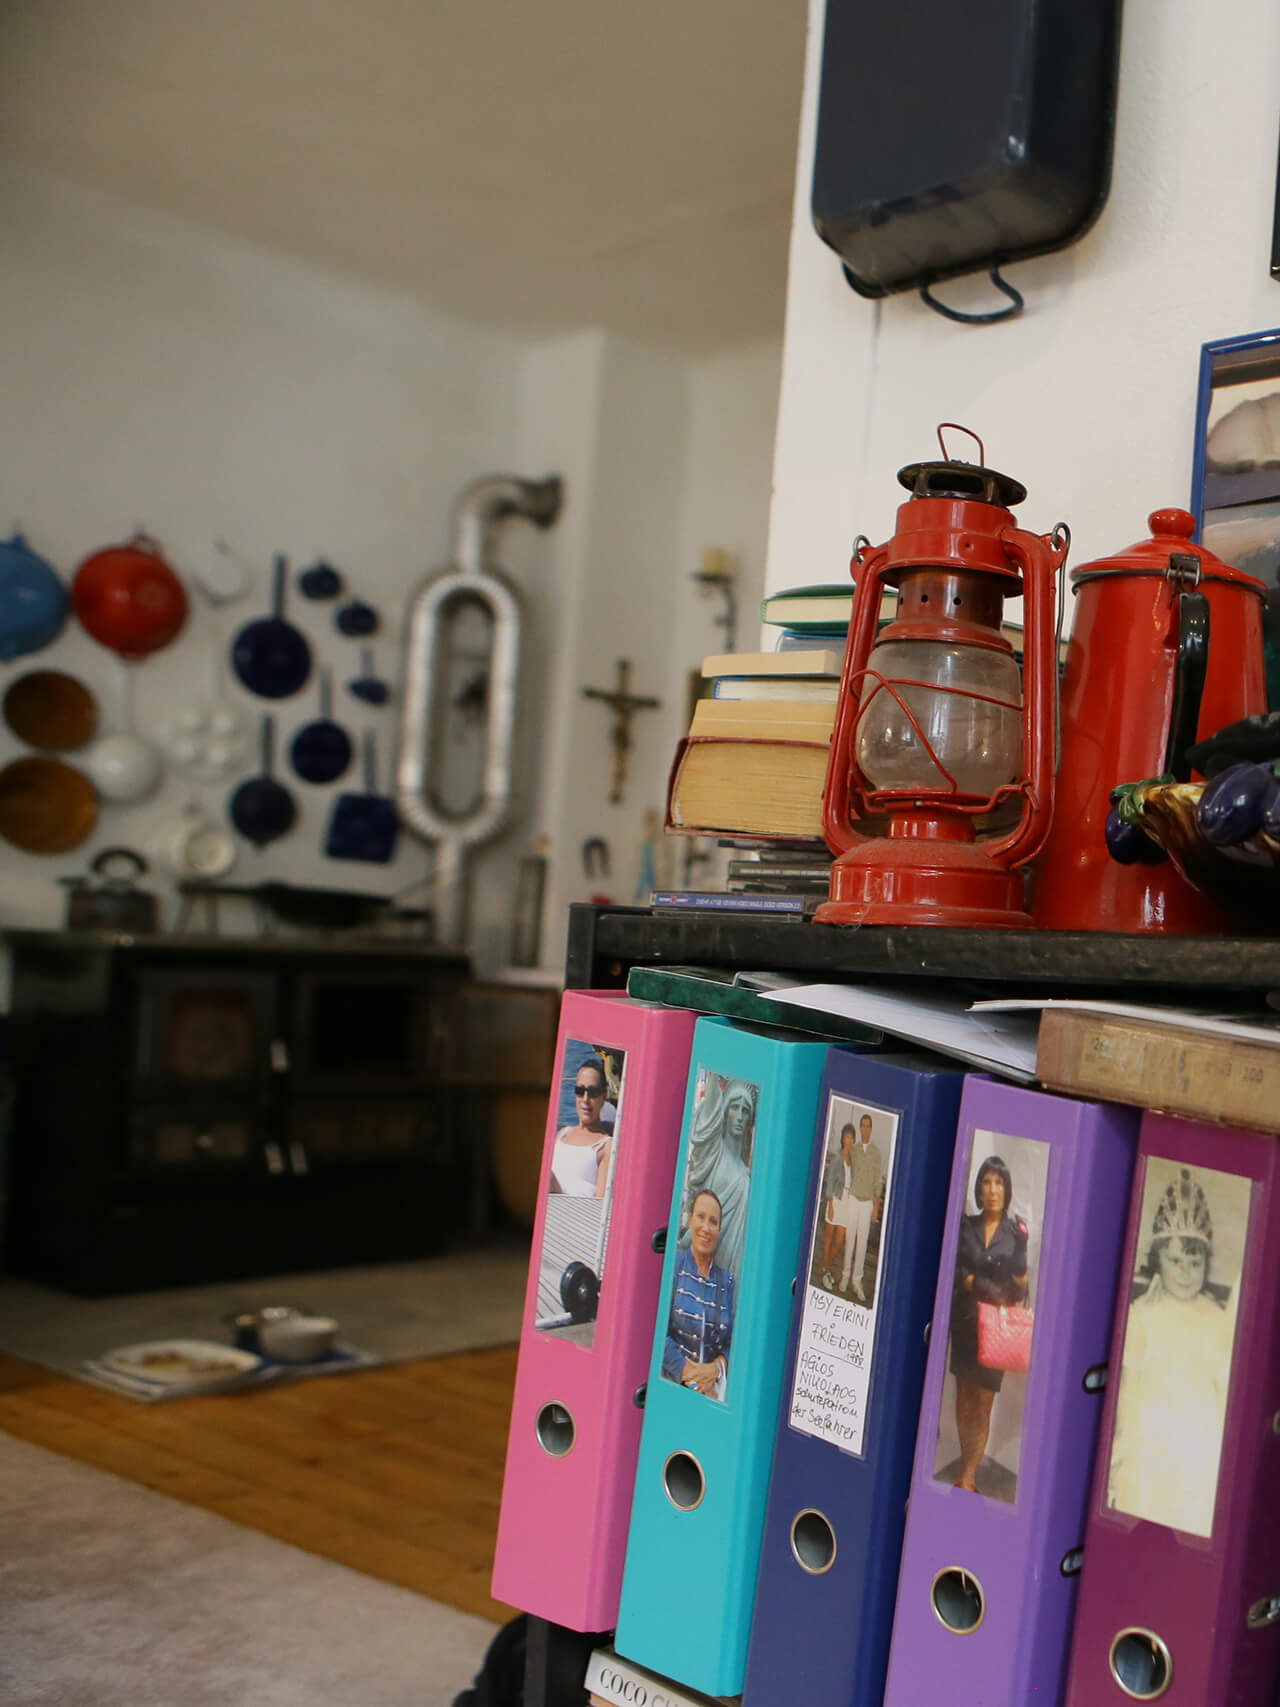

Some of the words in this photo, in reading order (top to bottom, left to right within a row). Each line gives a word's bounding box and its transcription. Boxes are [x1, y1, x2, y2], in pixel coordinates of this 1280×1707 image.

[833, 1306, 870, 1330] EIRINI
[811, 1322, 865, 1356] FRIEDEN
[600, 1667, 648, 1707] COCO
